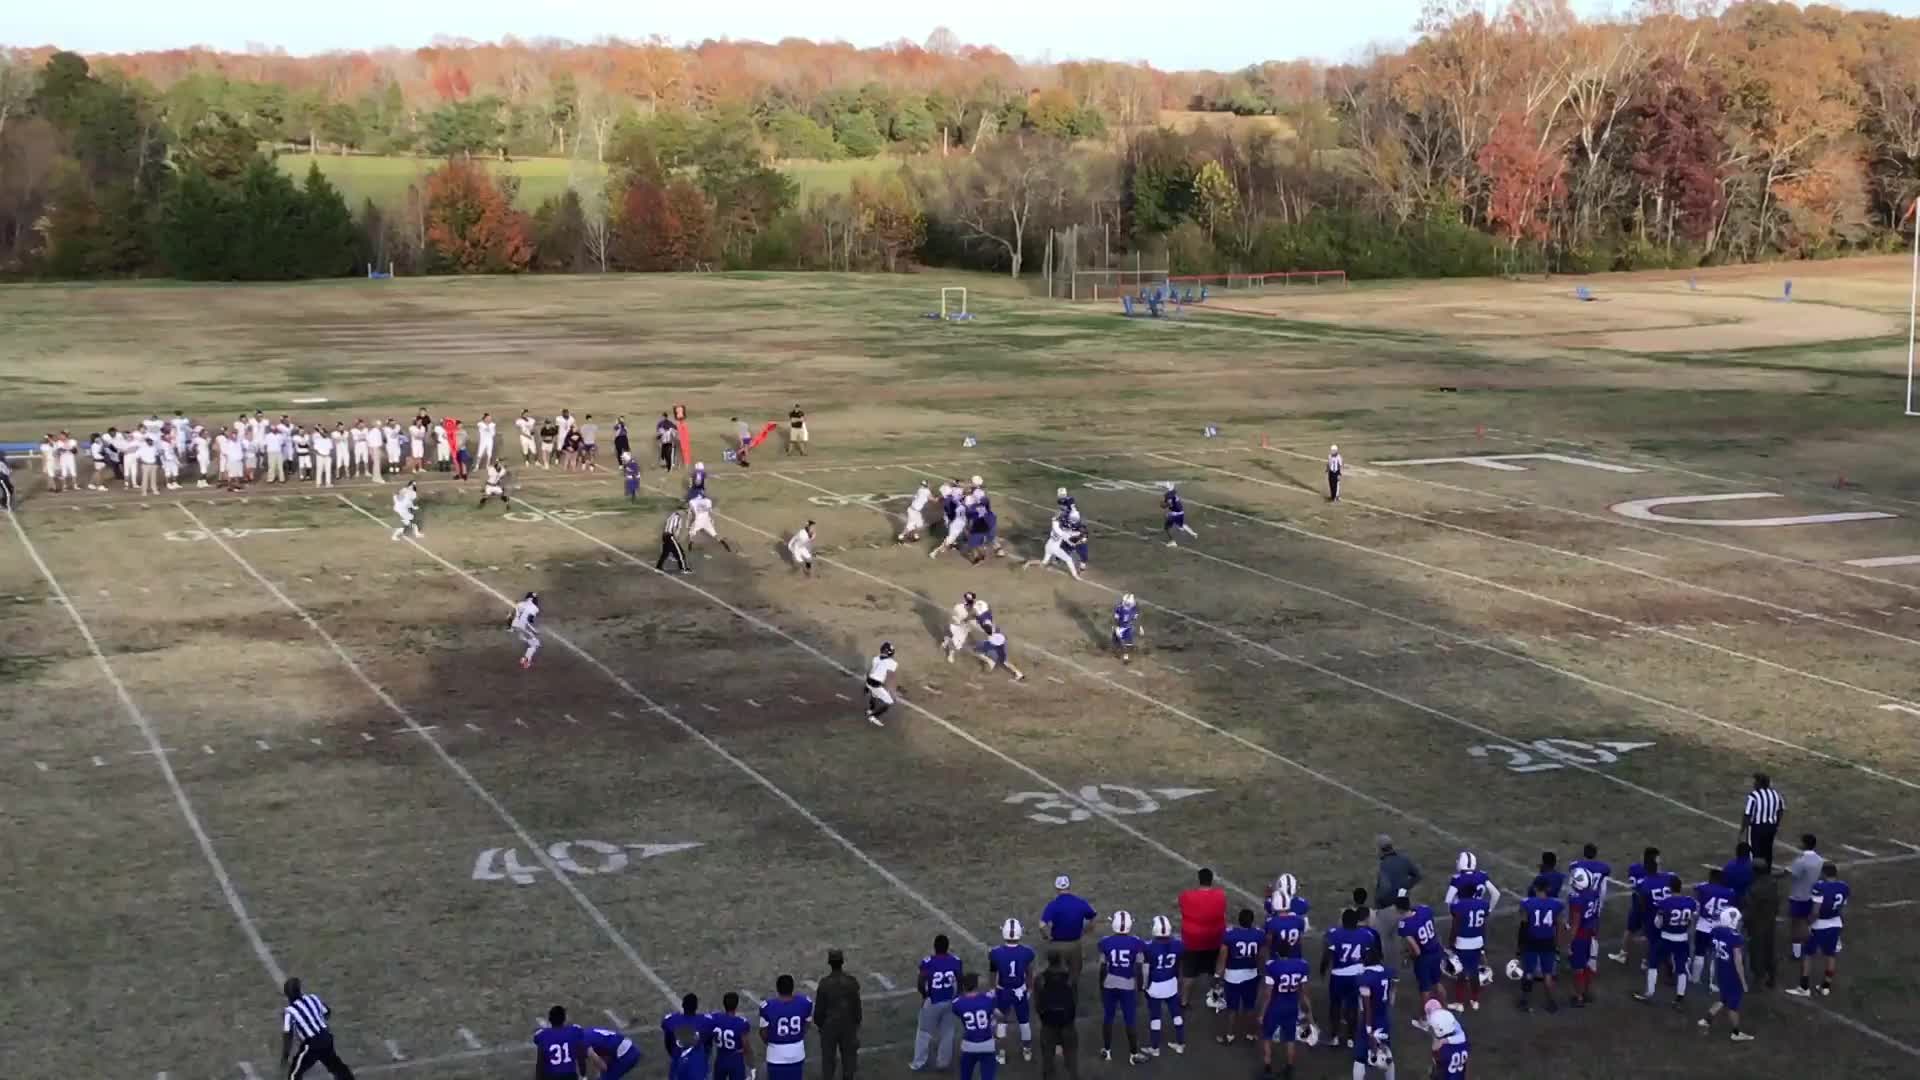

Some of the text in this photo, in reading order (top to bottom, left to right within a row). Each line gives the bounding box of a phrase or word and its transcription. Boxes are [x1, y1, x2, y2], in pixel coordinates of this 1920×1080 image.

[1002, 784, 1160, 825] 30
[472, 839, 629, 885] 40
[1467, 909, 1486, 928] 16
[1534, 908, 1554, 928] 14
[1417, 919, 1435, 946] 90
[1110, 949, 1130, 968] 15
[1157, 953, 1177, 970] 13
[1341, 943, 1362, 963] 74
[1008, 960, 1018, 978] 1
[932, 970, 955, 989] 23
[1278, 973, 1302, 993] 25
[776, 1015, 801, 1038] 69
[549, 1042, 573, 1065] 31
